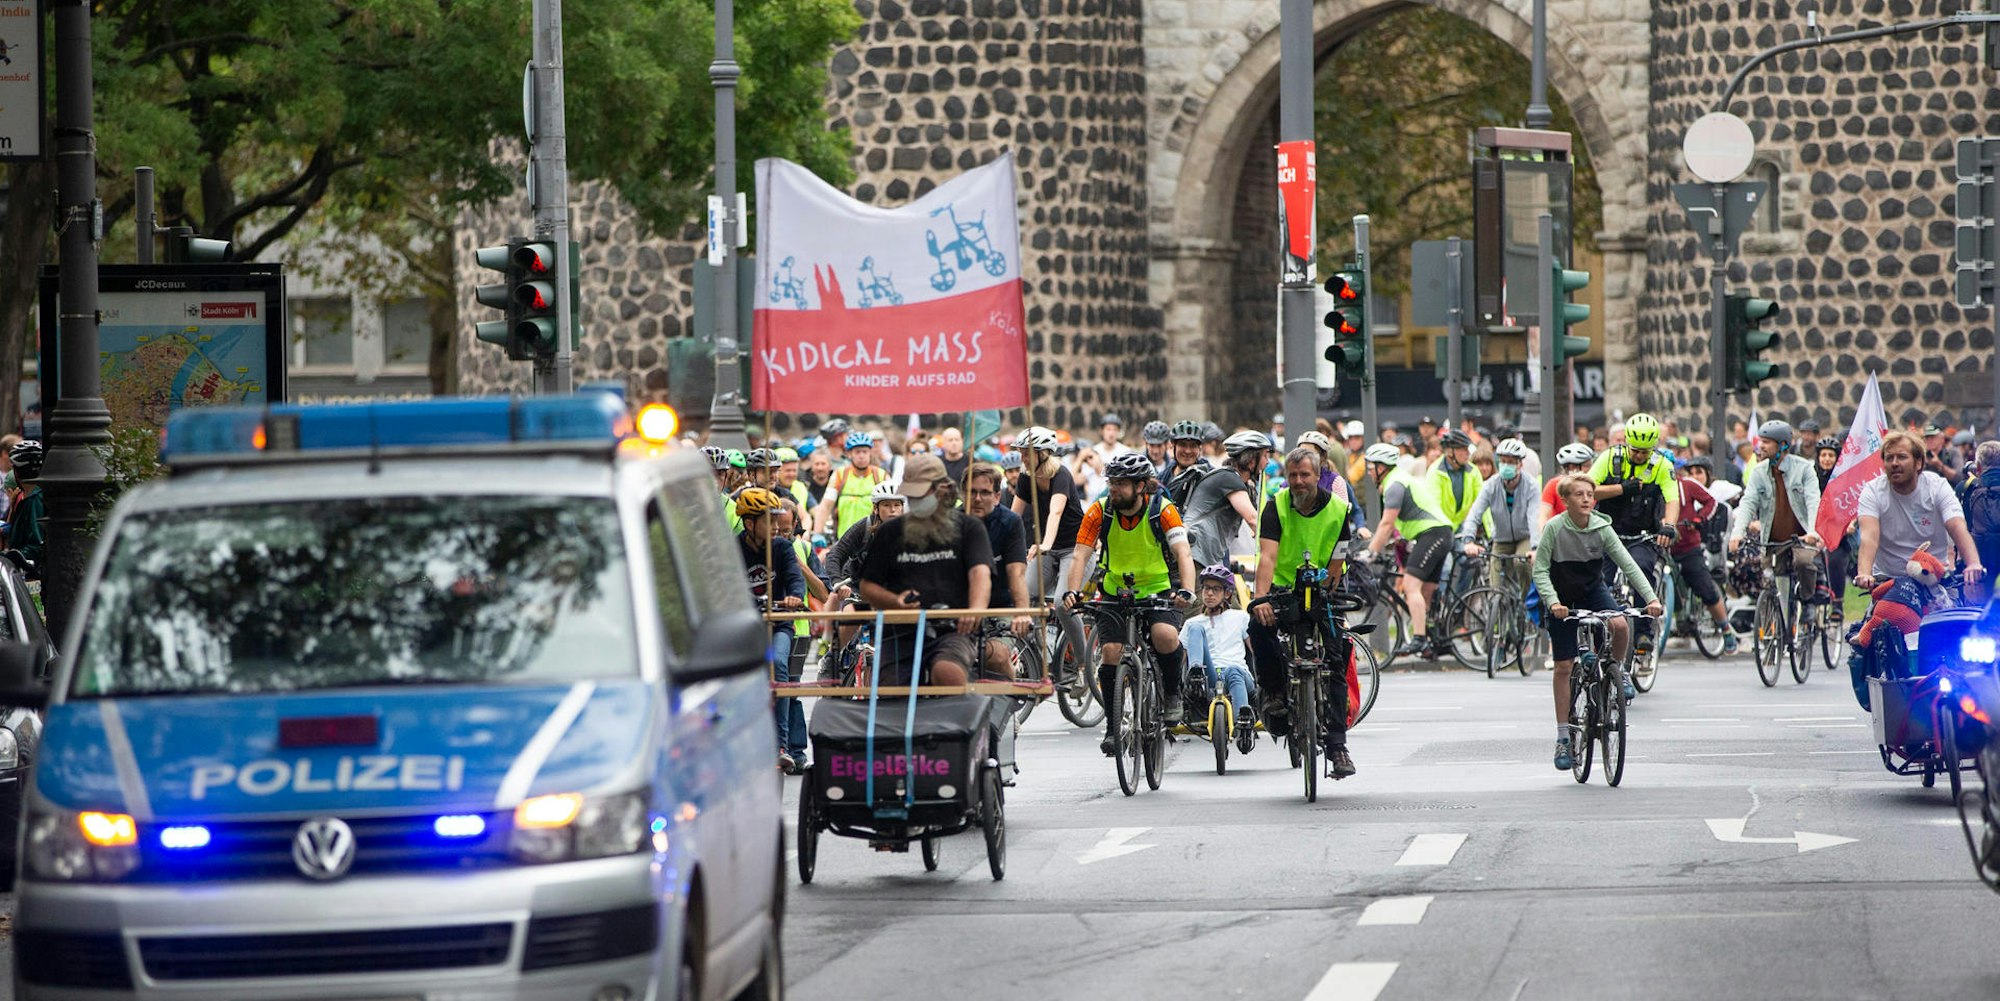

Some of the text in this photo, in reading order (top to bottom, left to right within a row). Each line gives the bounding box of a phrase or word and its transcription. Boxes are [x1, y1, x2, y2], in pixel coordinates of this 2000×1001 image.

[135, 280, 187, 289] JCDecaux
[202, 306, 240, 315] Stadt Köln
[988, 310, 1018, 337] Köln
[761, 331, 982, 383] KIDICAL MASS
[844, 374, 900, 388] KINDER
[191, 755, 465, 799] POLIZEI
[831, 755, 950, 781] EigelBike
